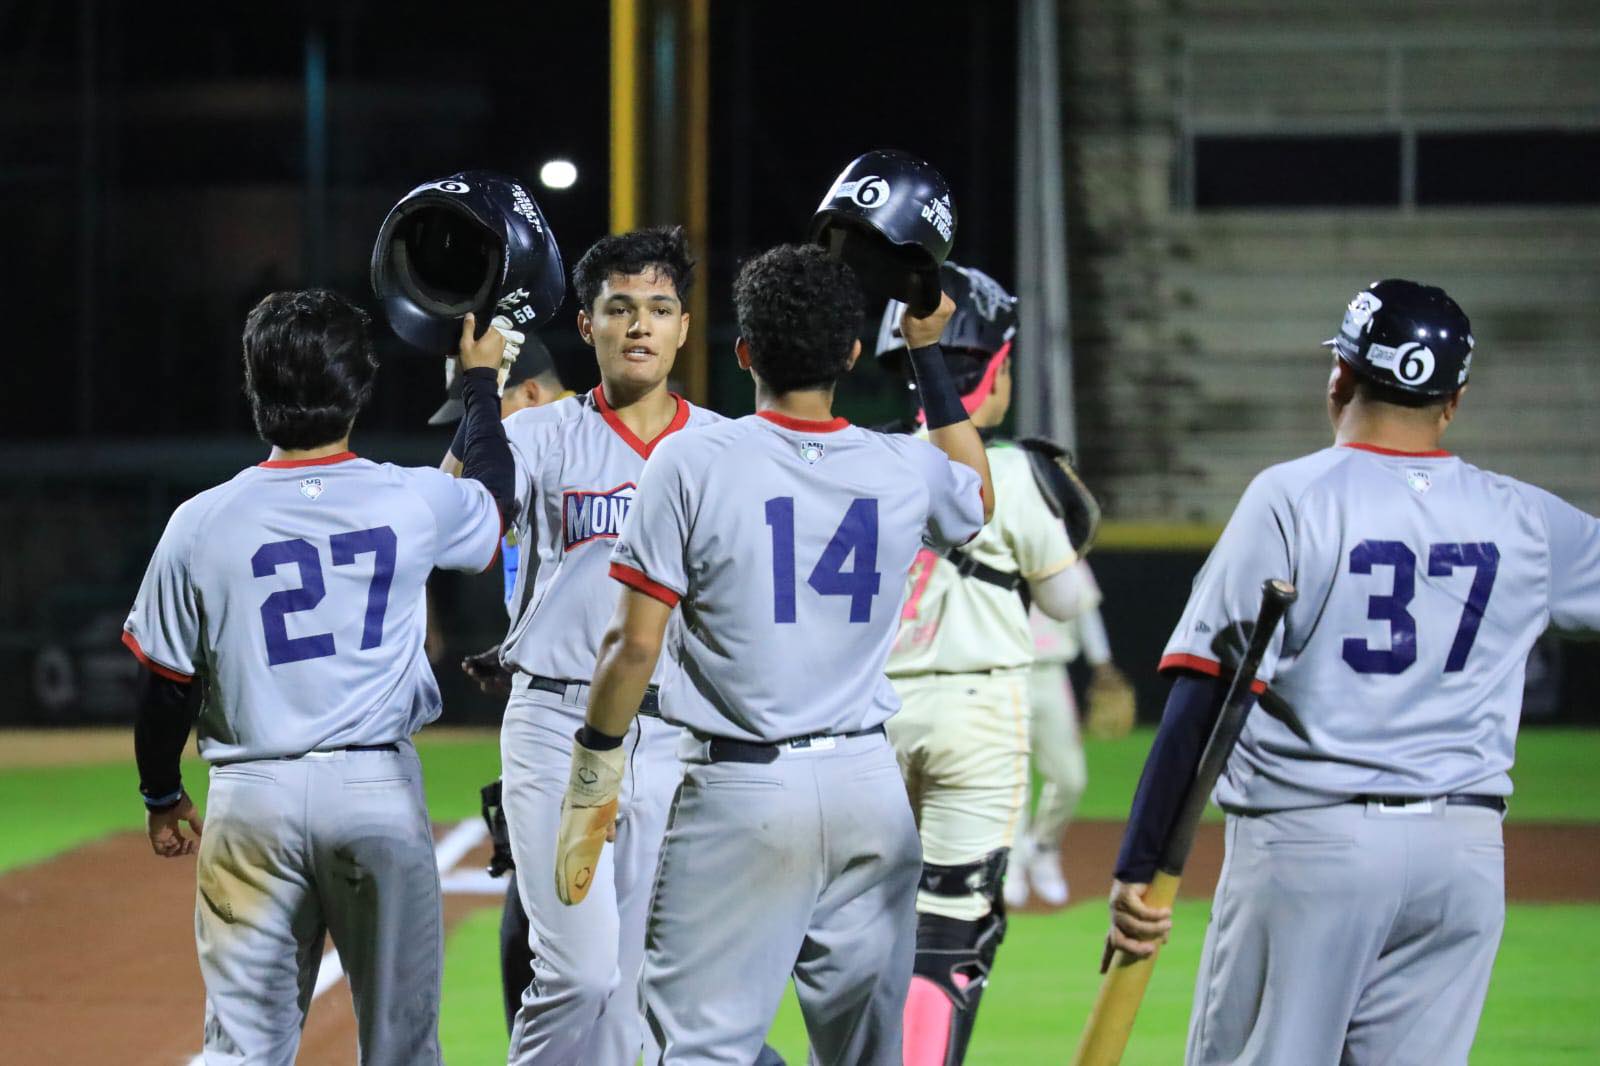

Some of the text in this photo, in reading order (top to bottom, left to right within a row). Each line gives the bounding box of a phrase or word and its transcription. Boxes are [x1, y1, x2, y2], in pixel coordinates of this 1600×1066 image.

[857, 177, 884, 206] 6
[921, 205, 936, 222] DE
[512, 304, 536, 325] 58
[1400, 345, 1426, 381] 6
[566, 494, 631, 543] MON
[765, 496, 881, 623] 14
[251, 525, 397, 666] 27
[1342, 539, 1501, 675] 37
